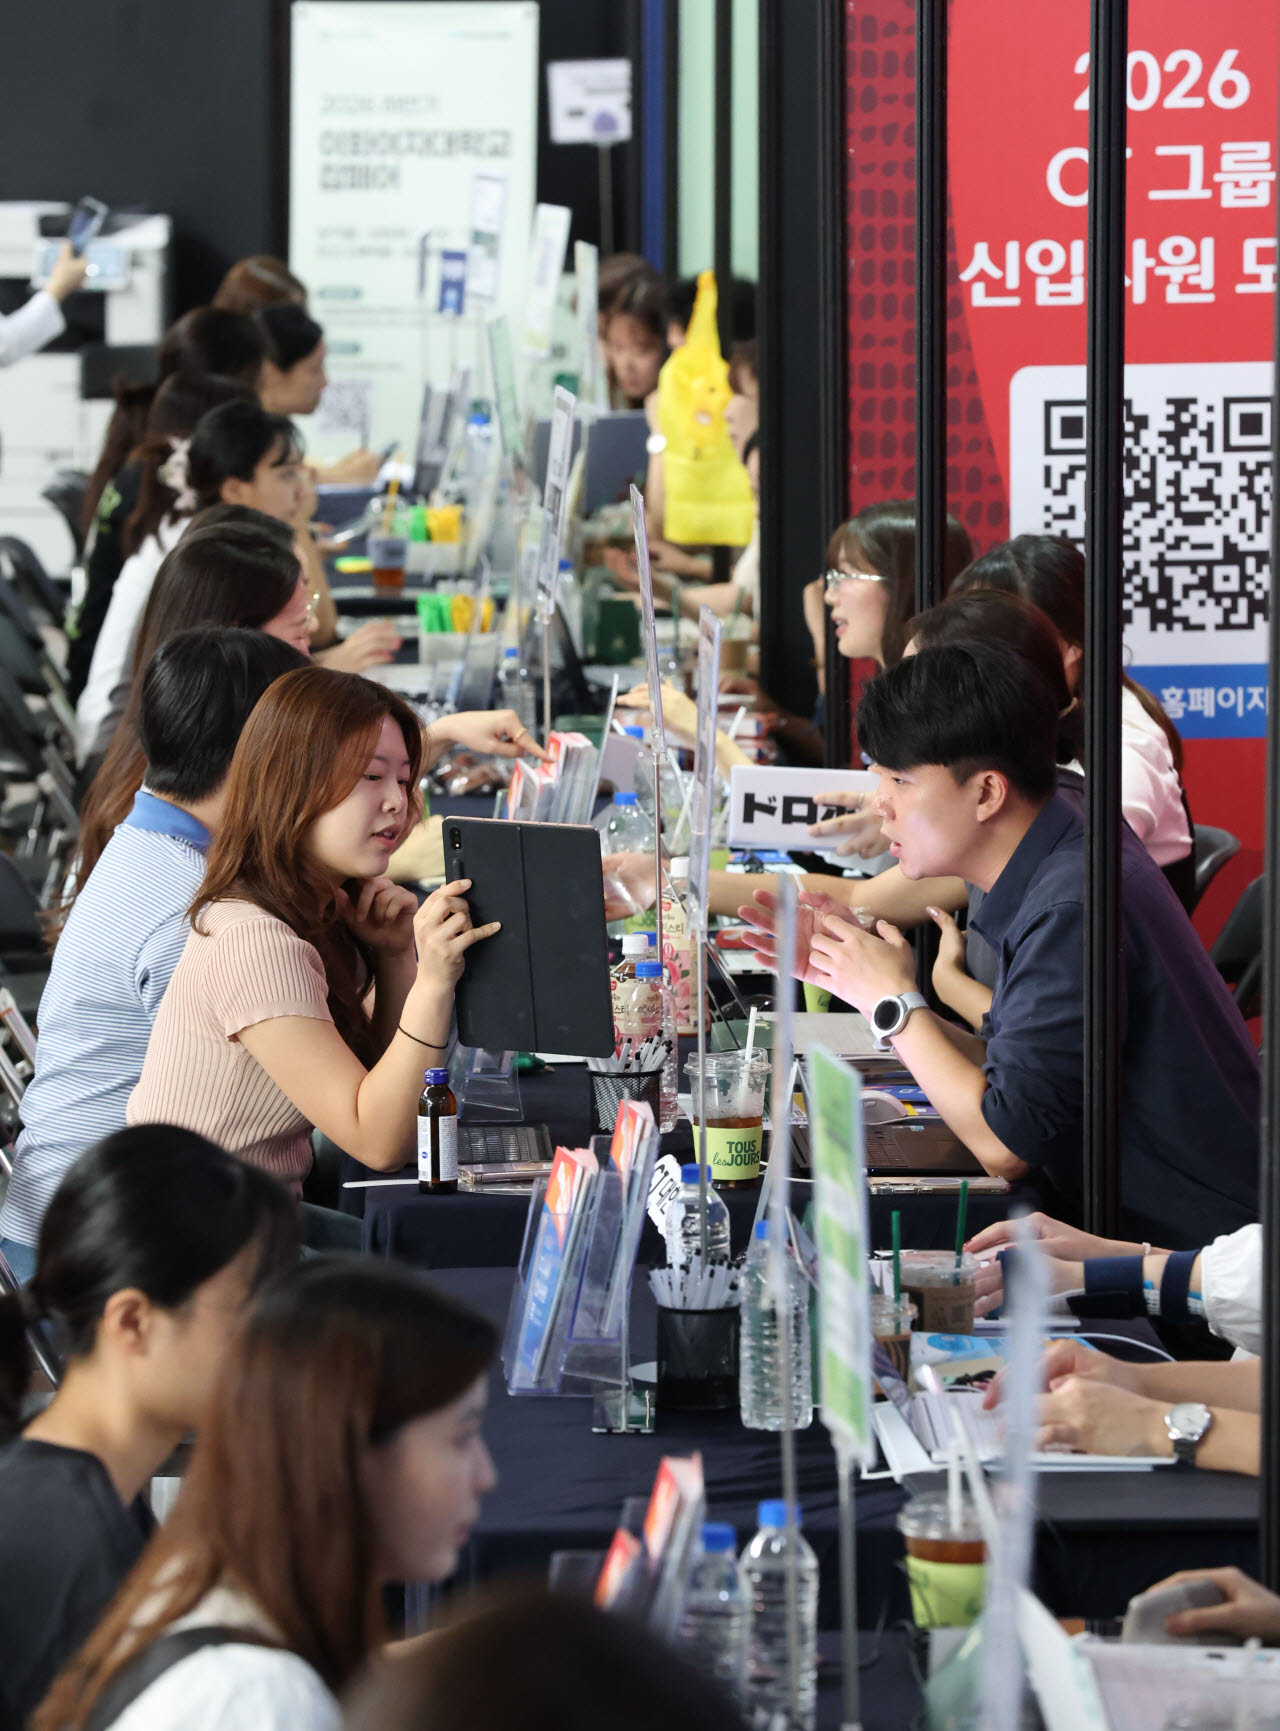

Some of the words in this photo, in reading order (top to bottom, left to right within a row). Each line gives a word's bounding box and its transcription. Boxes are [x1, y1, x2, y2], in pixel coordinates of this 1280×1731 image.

[1046, 147, 1132, 207] C
[1148, 141, 1277, 207] 그룹
[1161, 686, 1269, 719] 홈페이지
[713, 1152, 726, 1165] les
[726, 1151, 760, 1166] JOURS
[726, 1140, 756, 1153] TOUS
